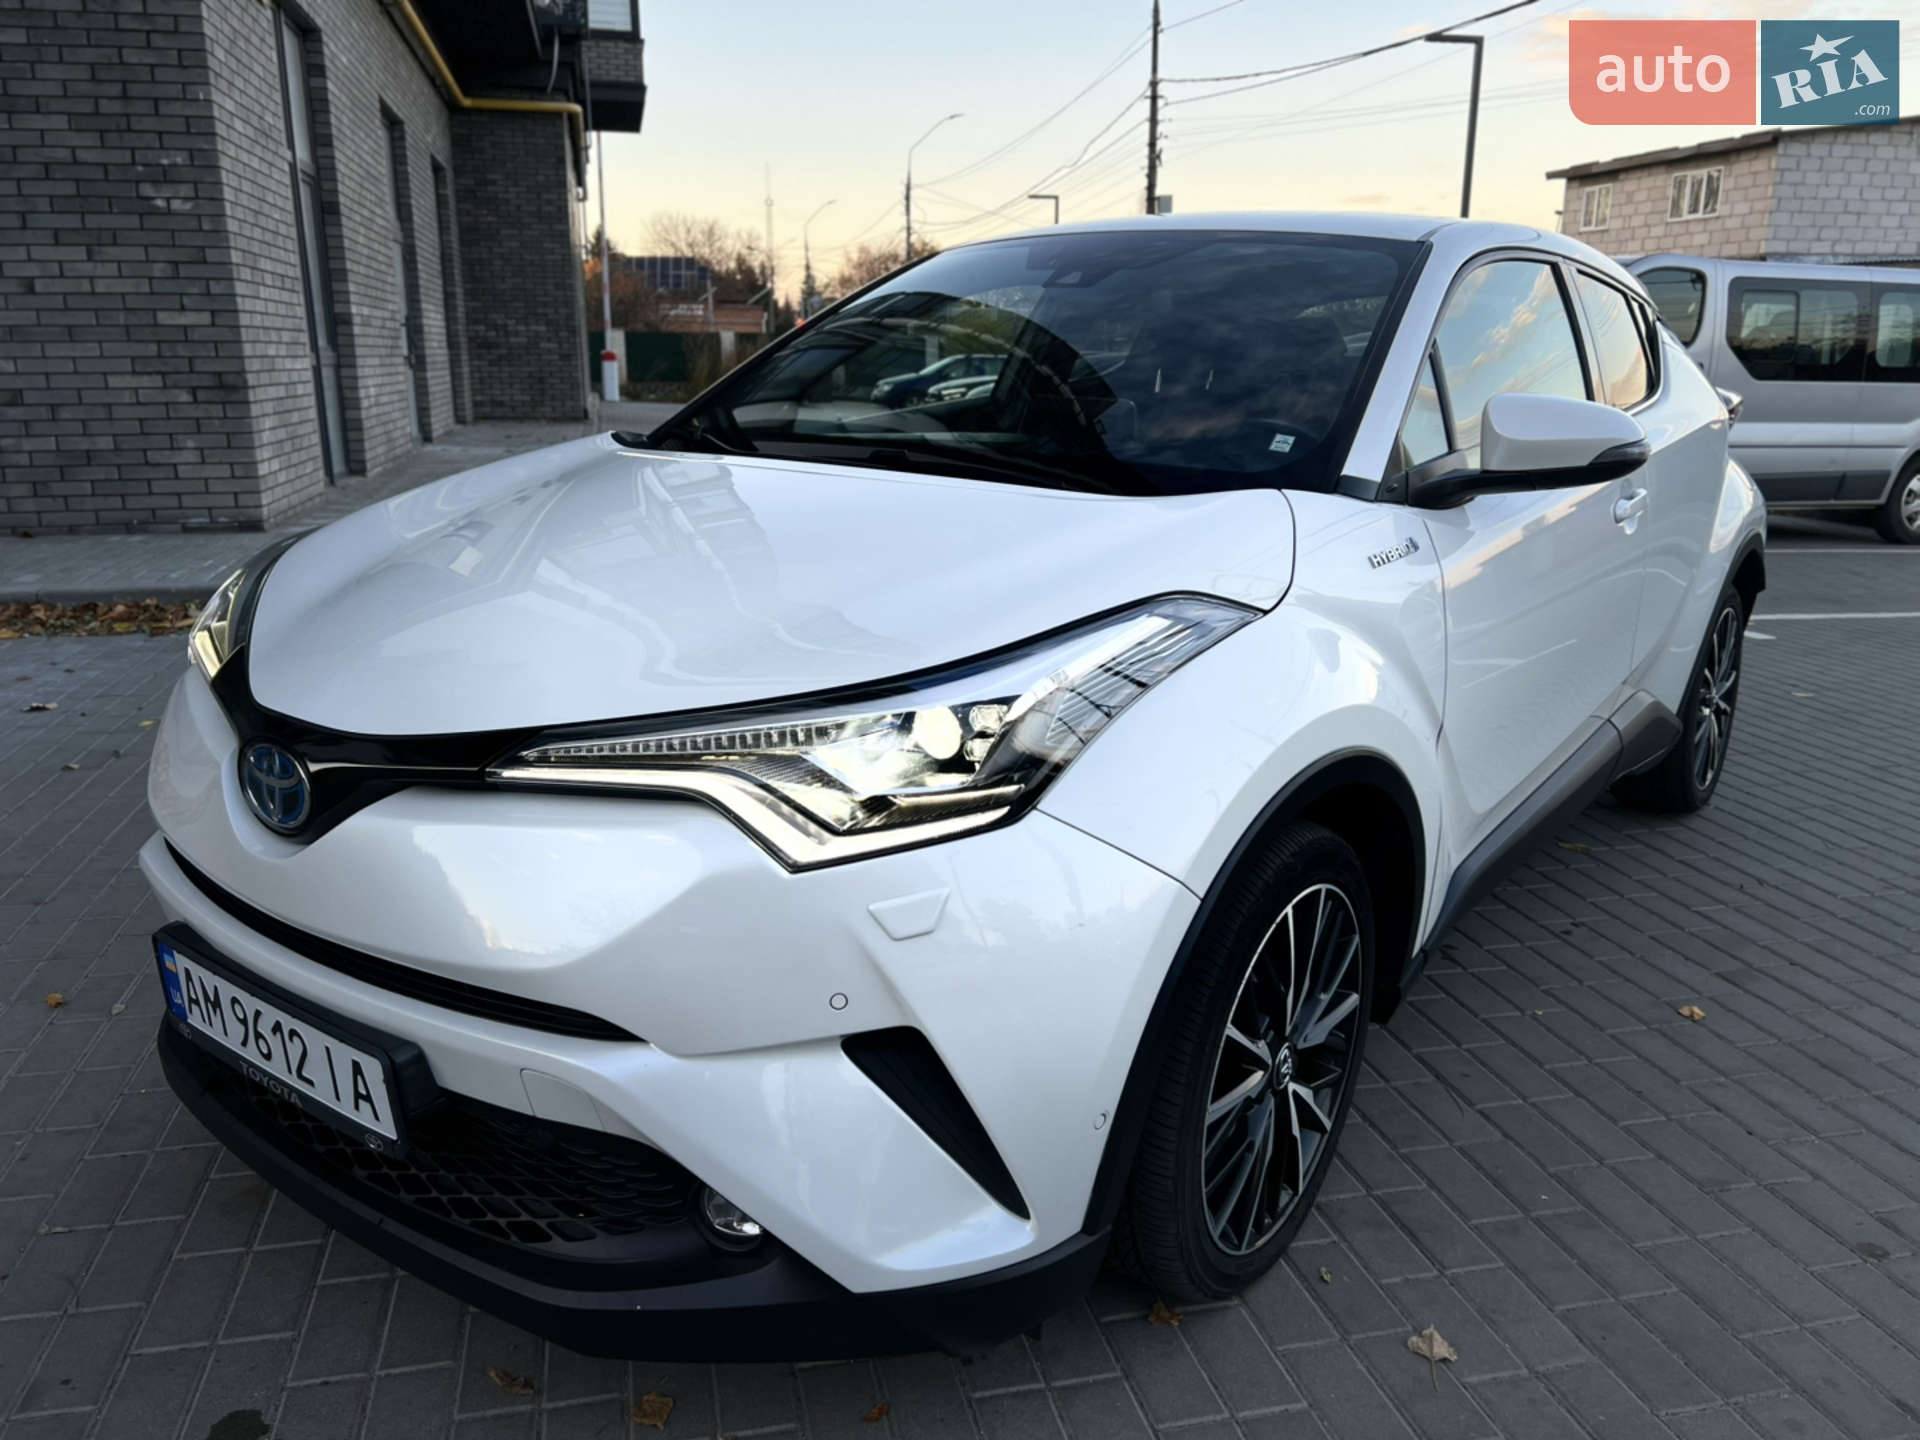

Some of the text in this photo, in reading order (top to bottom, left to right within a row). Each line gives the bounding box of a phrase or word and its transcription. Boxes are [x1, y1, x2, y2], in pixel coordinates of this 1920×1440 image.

[170, 986, 184, 1008] UA
[184, 966, 381, 1122] AM 9612 IA
[239, 1060, 304, 1108] TOYOTA
